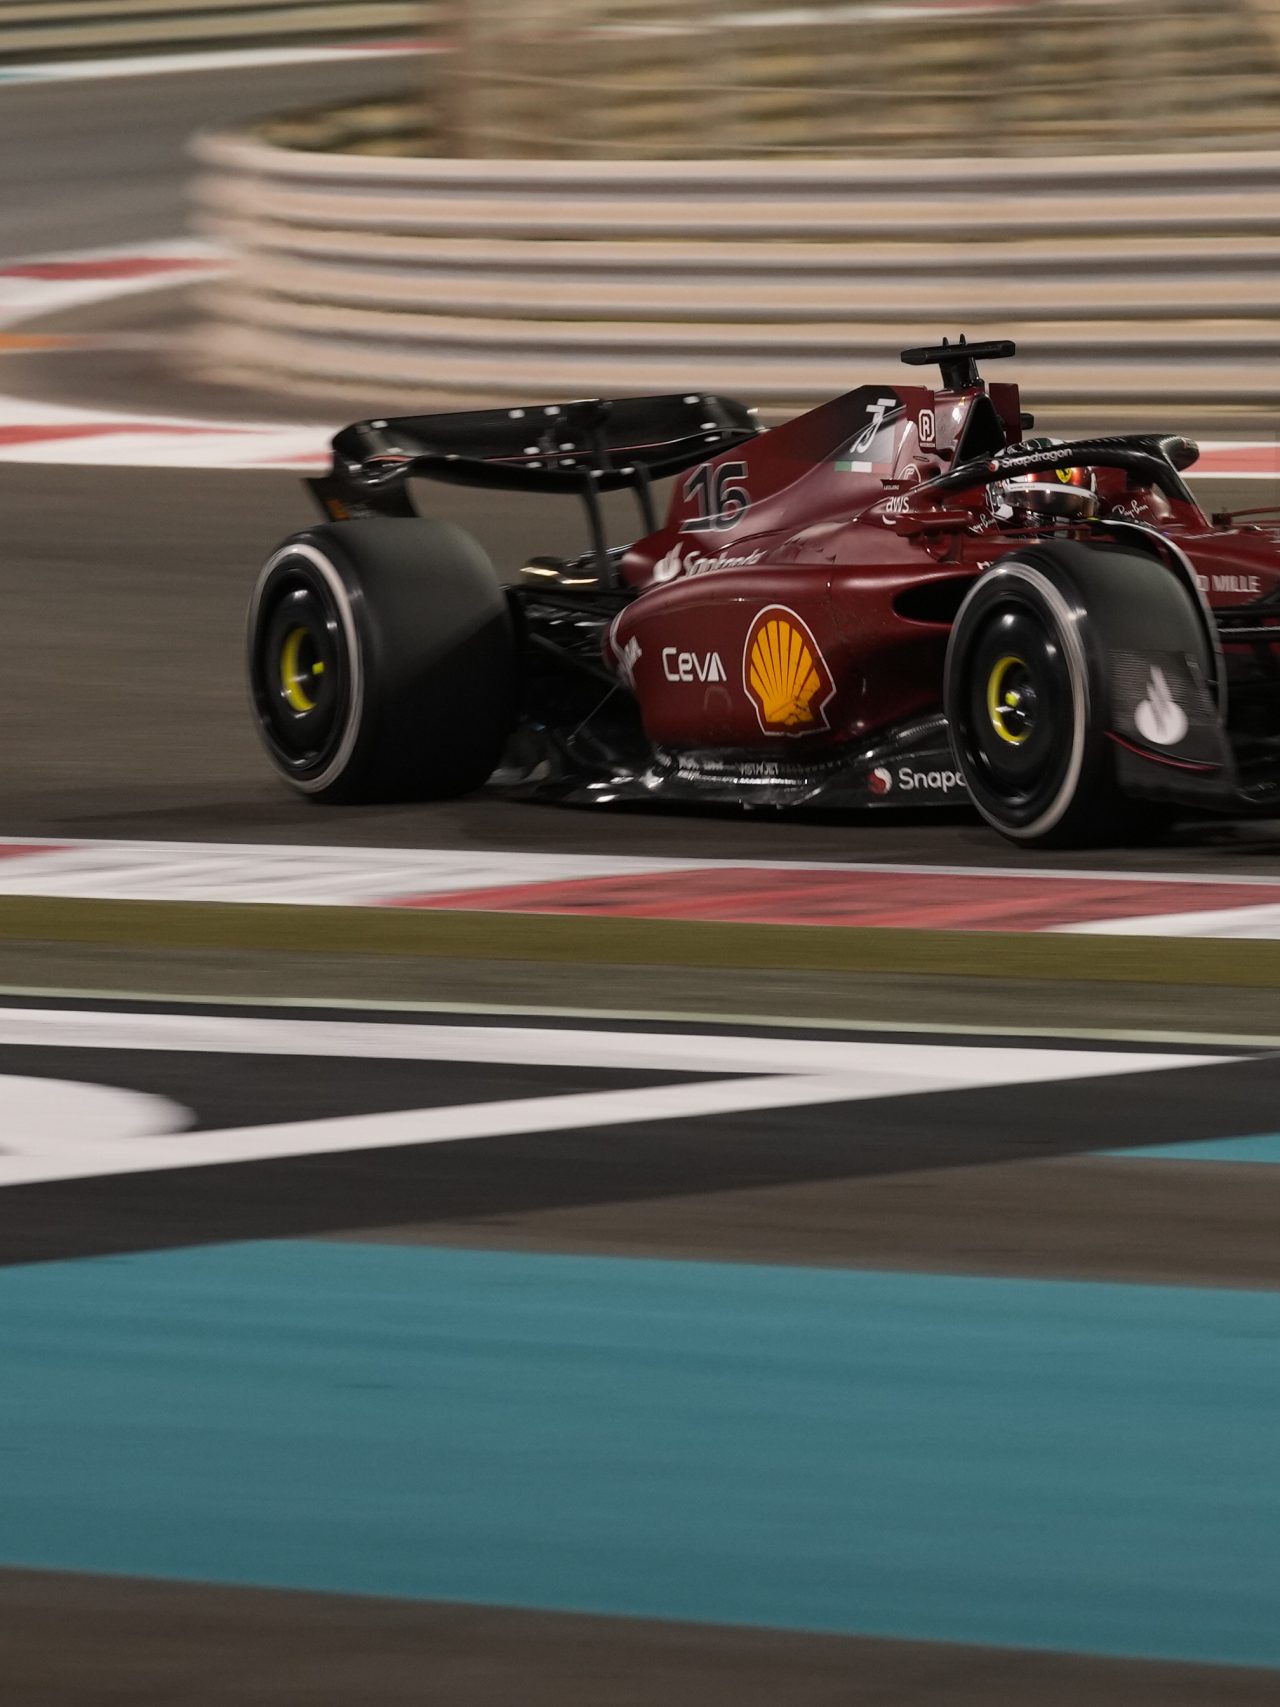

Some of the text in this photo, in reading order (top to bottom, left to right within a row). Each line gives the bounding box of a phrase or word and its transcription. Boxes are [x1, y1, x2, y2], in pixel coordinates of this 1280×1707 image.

[1001, 449, 1072, 469] Snapdragon
[678, 461, 752, 534] 16
[886, 497, 910, 512] aws
[1212, 574, 1261, 592] MILLE
